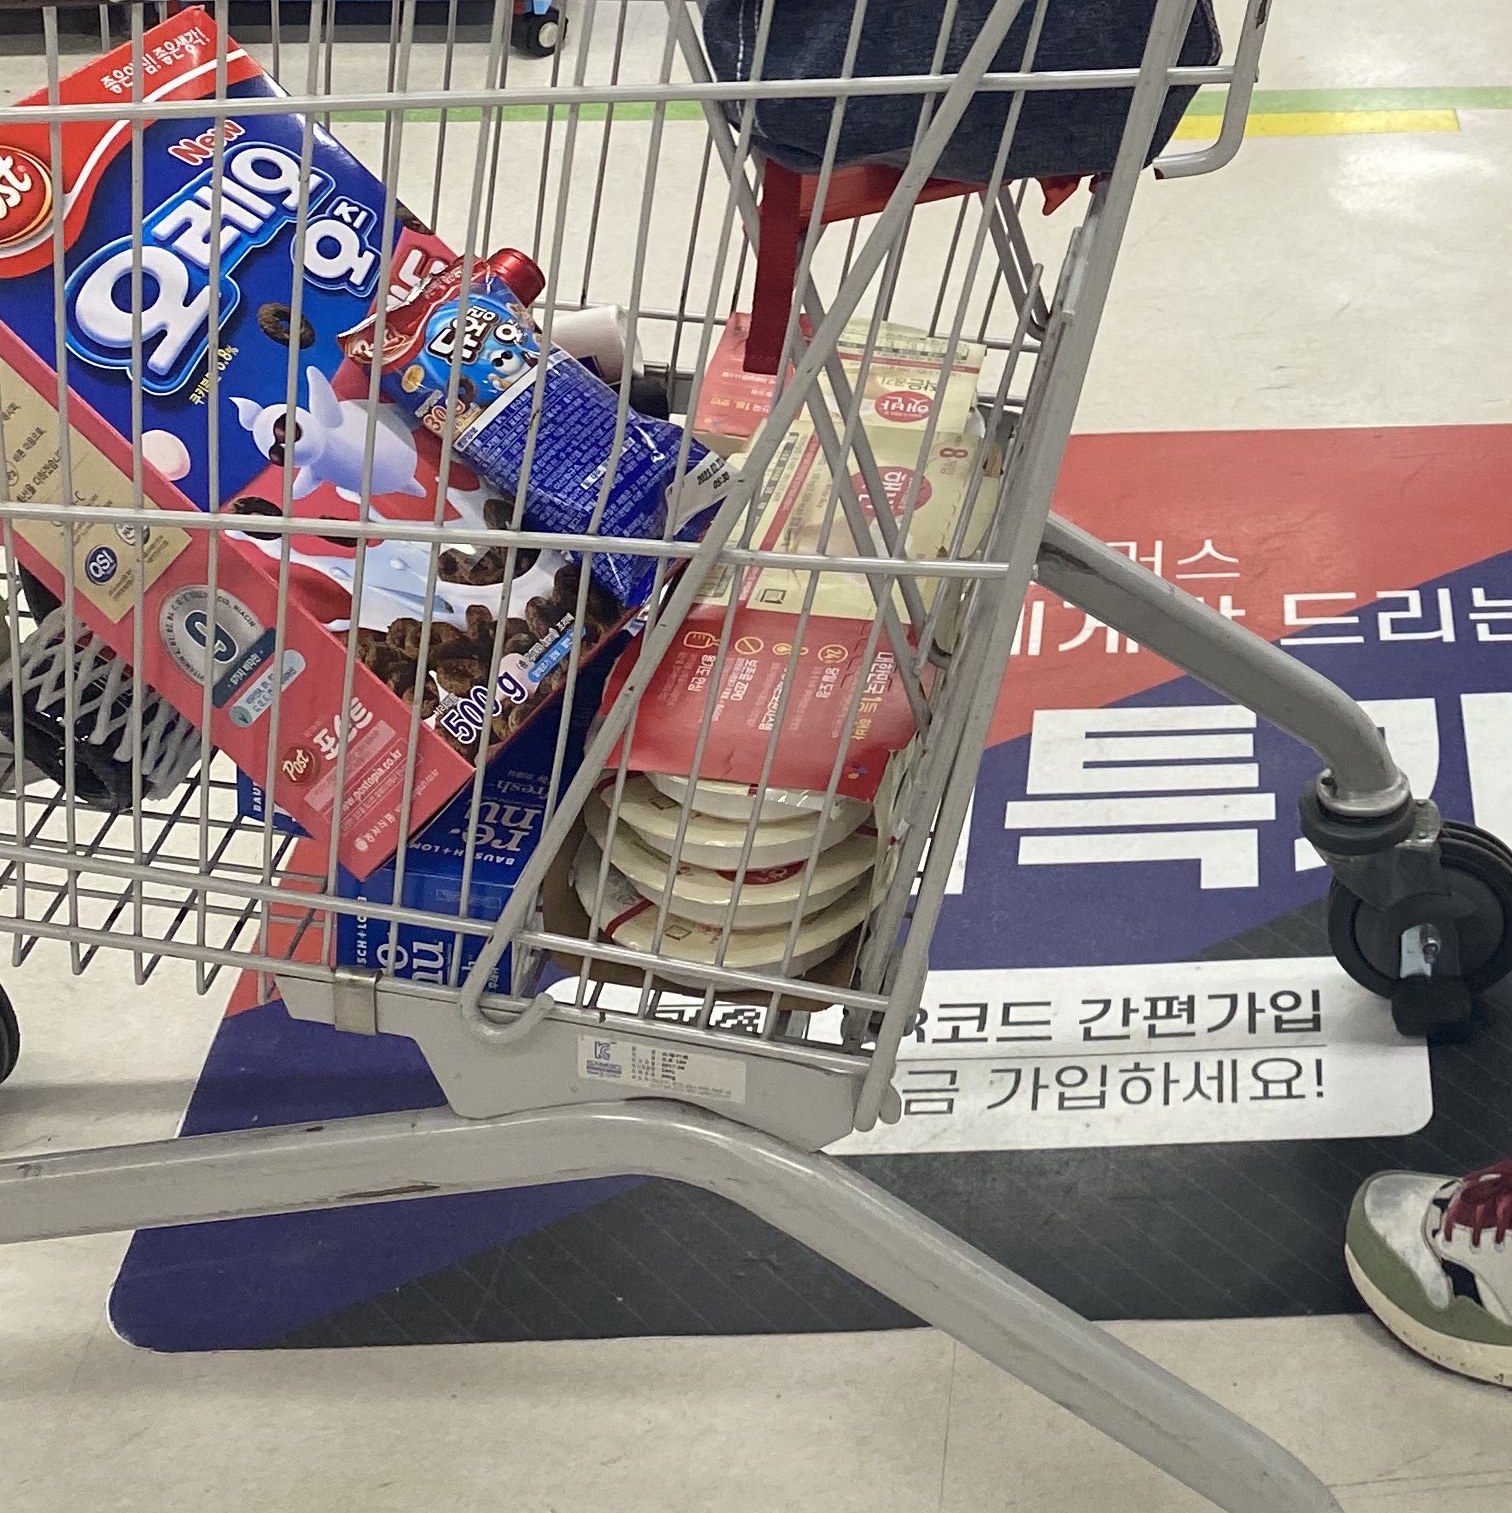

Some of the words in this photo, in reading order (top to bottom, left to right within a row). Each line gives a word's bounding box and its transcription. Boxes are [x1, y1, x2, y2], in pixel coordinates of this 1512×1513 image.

[168, 120, 245, 166] New
[75, 147, 324, 375] 오레오
[881, 395, 931, 415] 햇반
[440, 684, 503, 745] 500
[497, 670, 528, 705] g
[281, 748, 311, 782] Post
[341, 747, 404, 813] ww.postopia.co.kr
[1078, 989, 1323, 1044] 간편가입
[988, 1055, 1326, 1114] 가입하세요!
